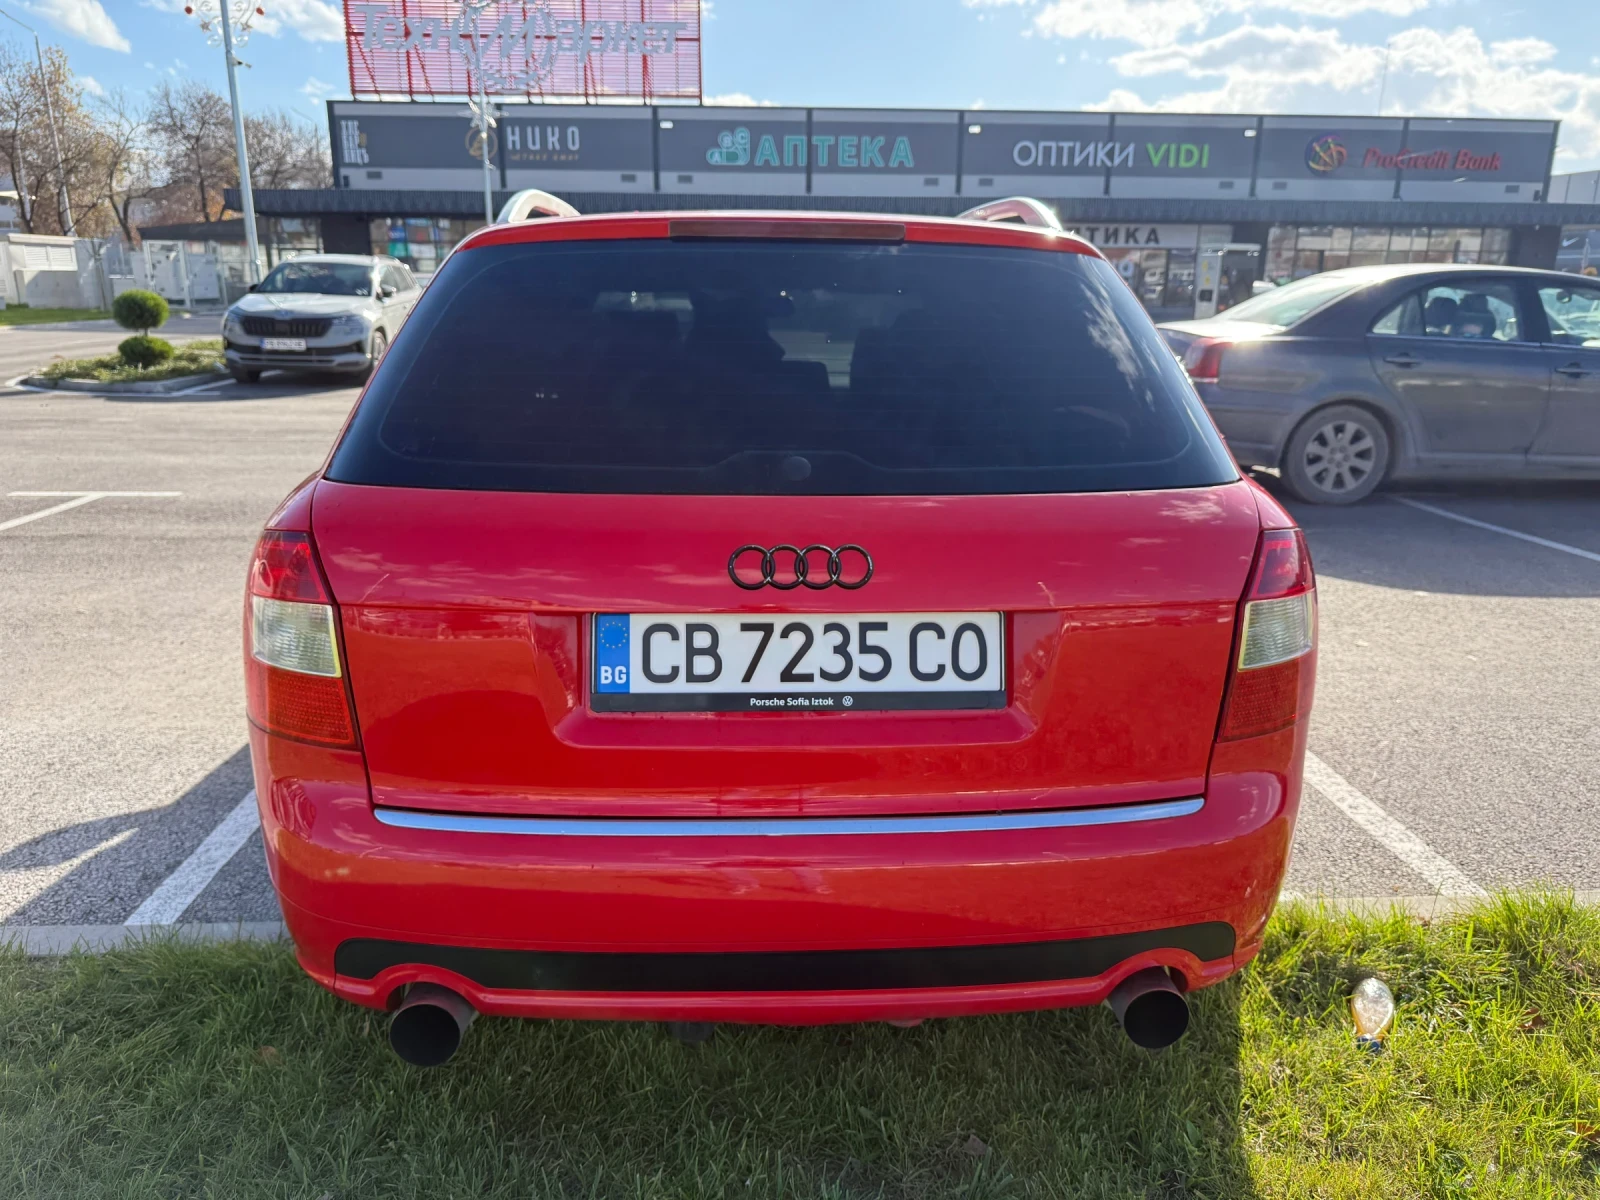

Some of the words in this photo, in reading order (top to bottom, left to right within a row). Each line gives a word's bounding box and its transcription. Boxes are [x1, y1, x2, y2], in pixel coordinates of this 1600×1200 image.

[754, 135, 915, 167] АПТЕКА
[1013, 140, 1135, 168] ОПТИКИ
[1146, 143, 1210, 168] VIDI
[1363, 147, 1451, 169] ProCredit
[1454, 149, 1502, 171] Bank
[740, 622, 892, 683] 7235
[600, 665, 627, 684] BG
[750, 697, 785, 706] Porsche
[786, 697, 809, 706] Sofia
[811, 697, 834, 706] Iztok
